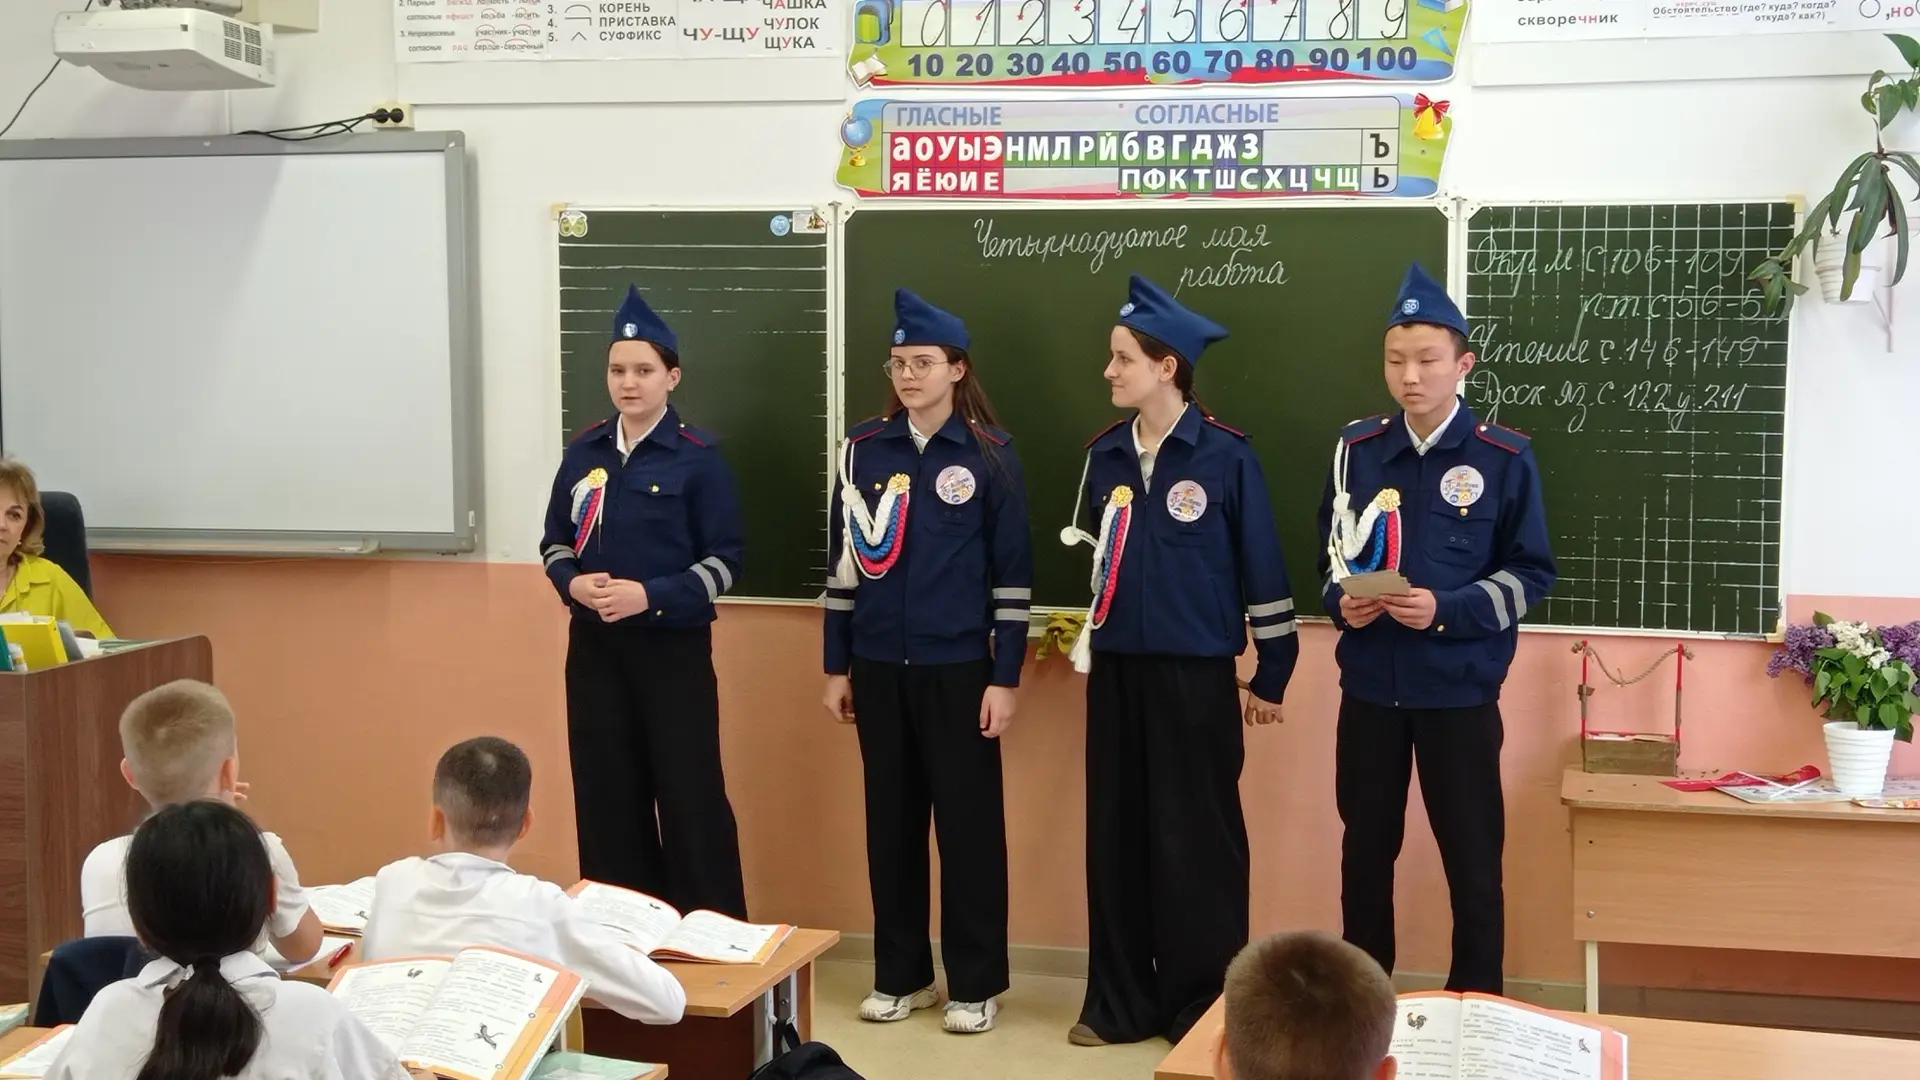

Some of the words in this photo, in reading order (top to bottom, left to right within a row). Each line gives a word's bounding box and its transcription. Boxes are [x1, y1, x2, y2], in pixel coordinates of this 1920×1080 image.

[547, 4, 557, 14] 3.
[599, 3, 651, 13] КОРЕНЬ
[763, 0, 827, 9] ЧАШКА
[1653, 5, 1738, 16] Обстоятельство
[1740, 3, 1766, 12] (где?
[1768, 2, 1799, 12] куда?
[1801, 0, 1837, 10] когда?
[547, 18, 558, 28] 4.
[599, 16, 676, 27] ПРИСТАВКА
[764, 17, 819, 30] ЧУЛОК
[921, 0, 948, 47] 0
[1016, 0, 1045, 45] 2
[1068, 0, 1096, 45] 3
[1118, 0, 1144, 44] 4
[1167, 0, 1196, 43] 5
[1219, 0, 1247, 42] 6
[1329, 0, 1351, 40] 8
[1380, 0, 1405, 39] 9
[1518, 13, 1618, 27] скворечник
[1755, 12, 1796, 23] откуда?
[1798, 11, 1826, 20] как?)
[548, 32, 558, 42] 5.
[599, 30, 662, 41] СУФФИКС
[683, 27, 760, 43] ЧУ-ЩУ
[764, 36, 815, 51] ЩУКА
[908, 54, 943, 77] 10
[956, 53, 993, 77] 20
[1006, 53, 1044, 76] 30
[1052, 52, 1089, 75] 40
[1104, 51, 1141, 74] 50
[1152, 50, 1191, 74] 60
[1204, 50, 1243, 73] 70
[1255, 49, 1294, 73] 80
[1309, 47, 1349, 71] 90
[1356, 46, 1417, 71] 100
[896, 106, 1002, 127] ГЛАСНЫЕ
[1135, 103, 1279, 125] СОГЛАСНЫЕ
[974, 218, 1188, 273] Четырнадцатое
[1202, 224, 1272, 249] мая
[1173, 248, 1289, 299] работа
[1468, 323, 1590, 365] Чтение
